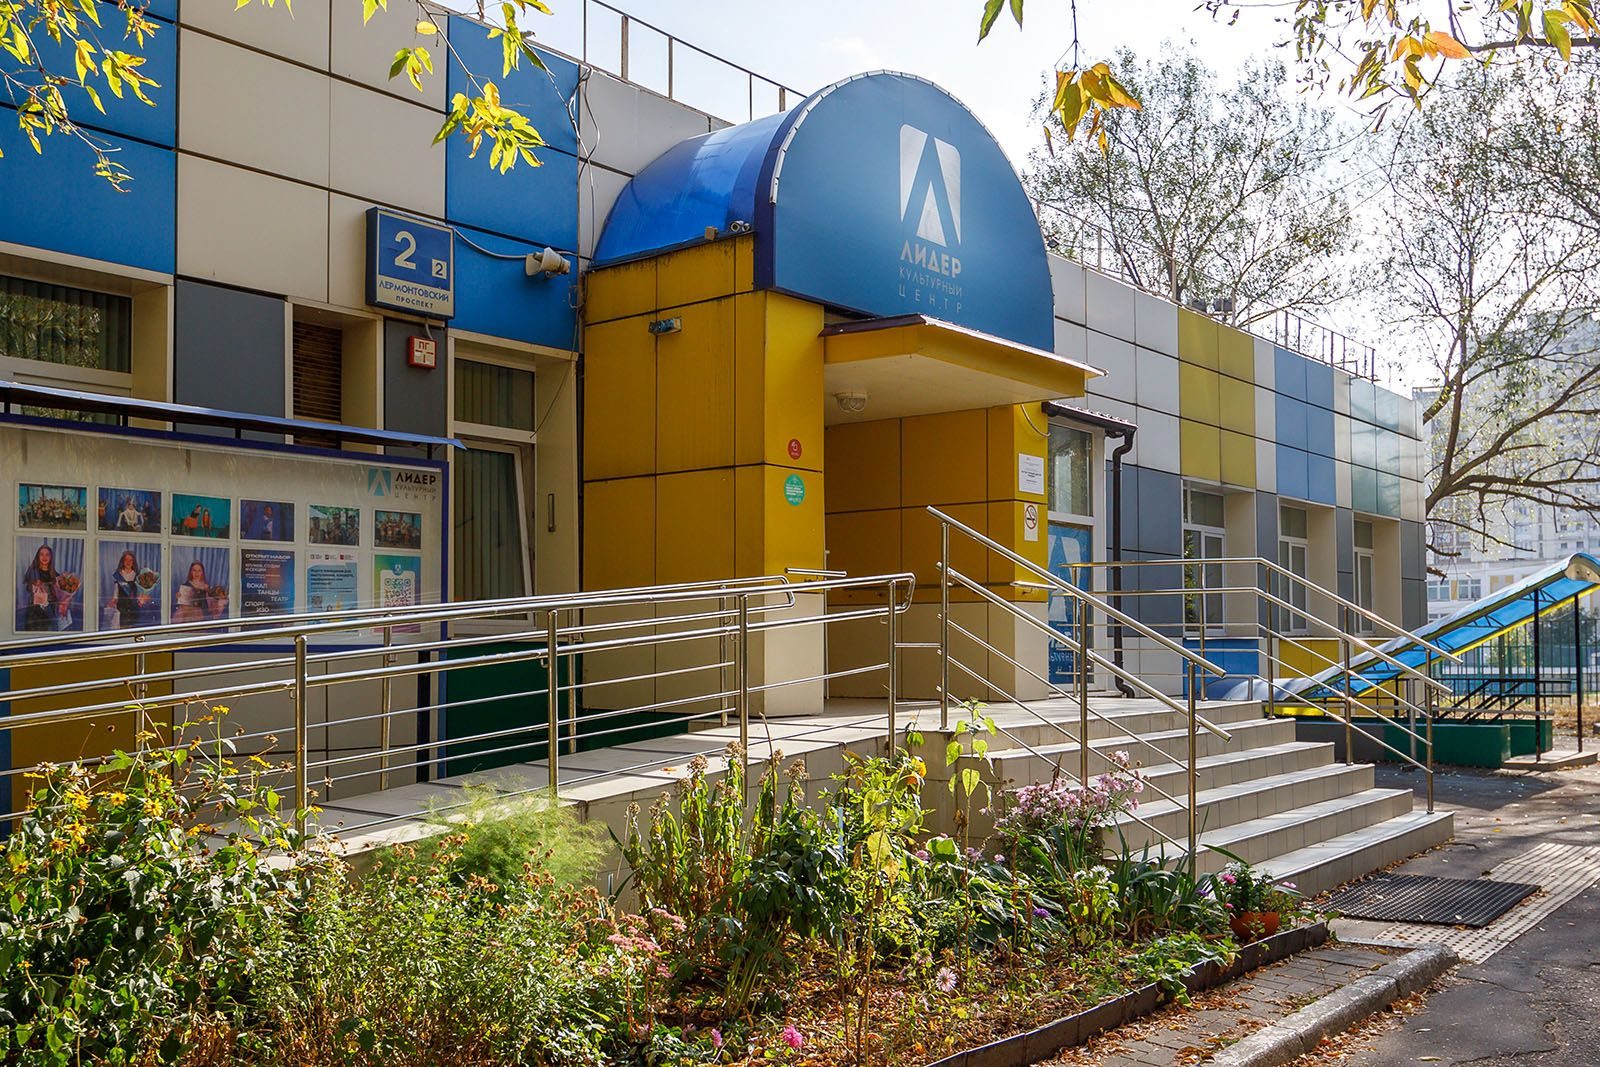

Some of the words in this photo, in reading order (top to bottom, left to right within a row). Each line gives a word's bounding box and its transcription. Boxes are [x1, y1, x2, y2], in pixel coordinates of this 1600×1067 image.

[394, 230, 417, 270] 2
[900, 239, 962, 278] ЛИДЕР
[435, 262, 443, 276] 2
[379, 279, 449, 302] ЛЕРМОНТОВСКИЙ
[899, 266, 962, 296] КУЛЬТУРНЫЙ
[396, 295, 434, 309] ПРОСПЕКТ
[898, 284, 962, 313] ЦЕНТР
[419, 341, 430, 350] ПГ
[395, 471, 436, 485] ЛИДЕР
